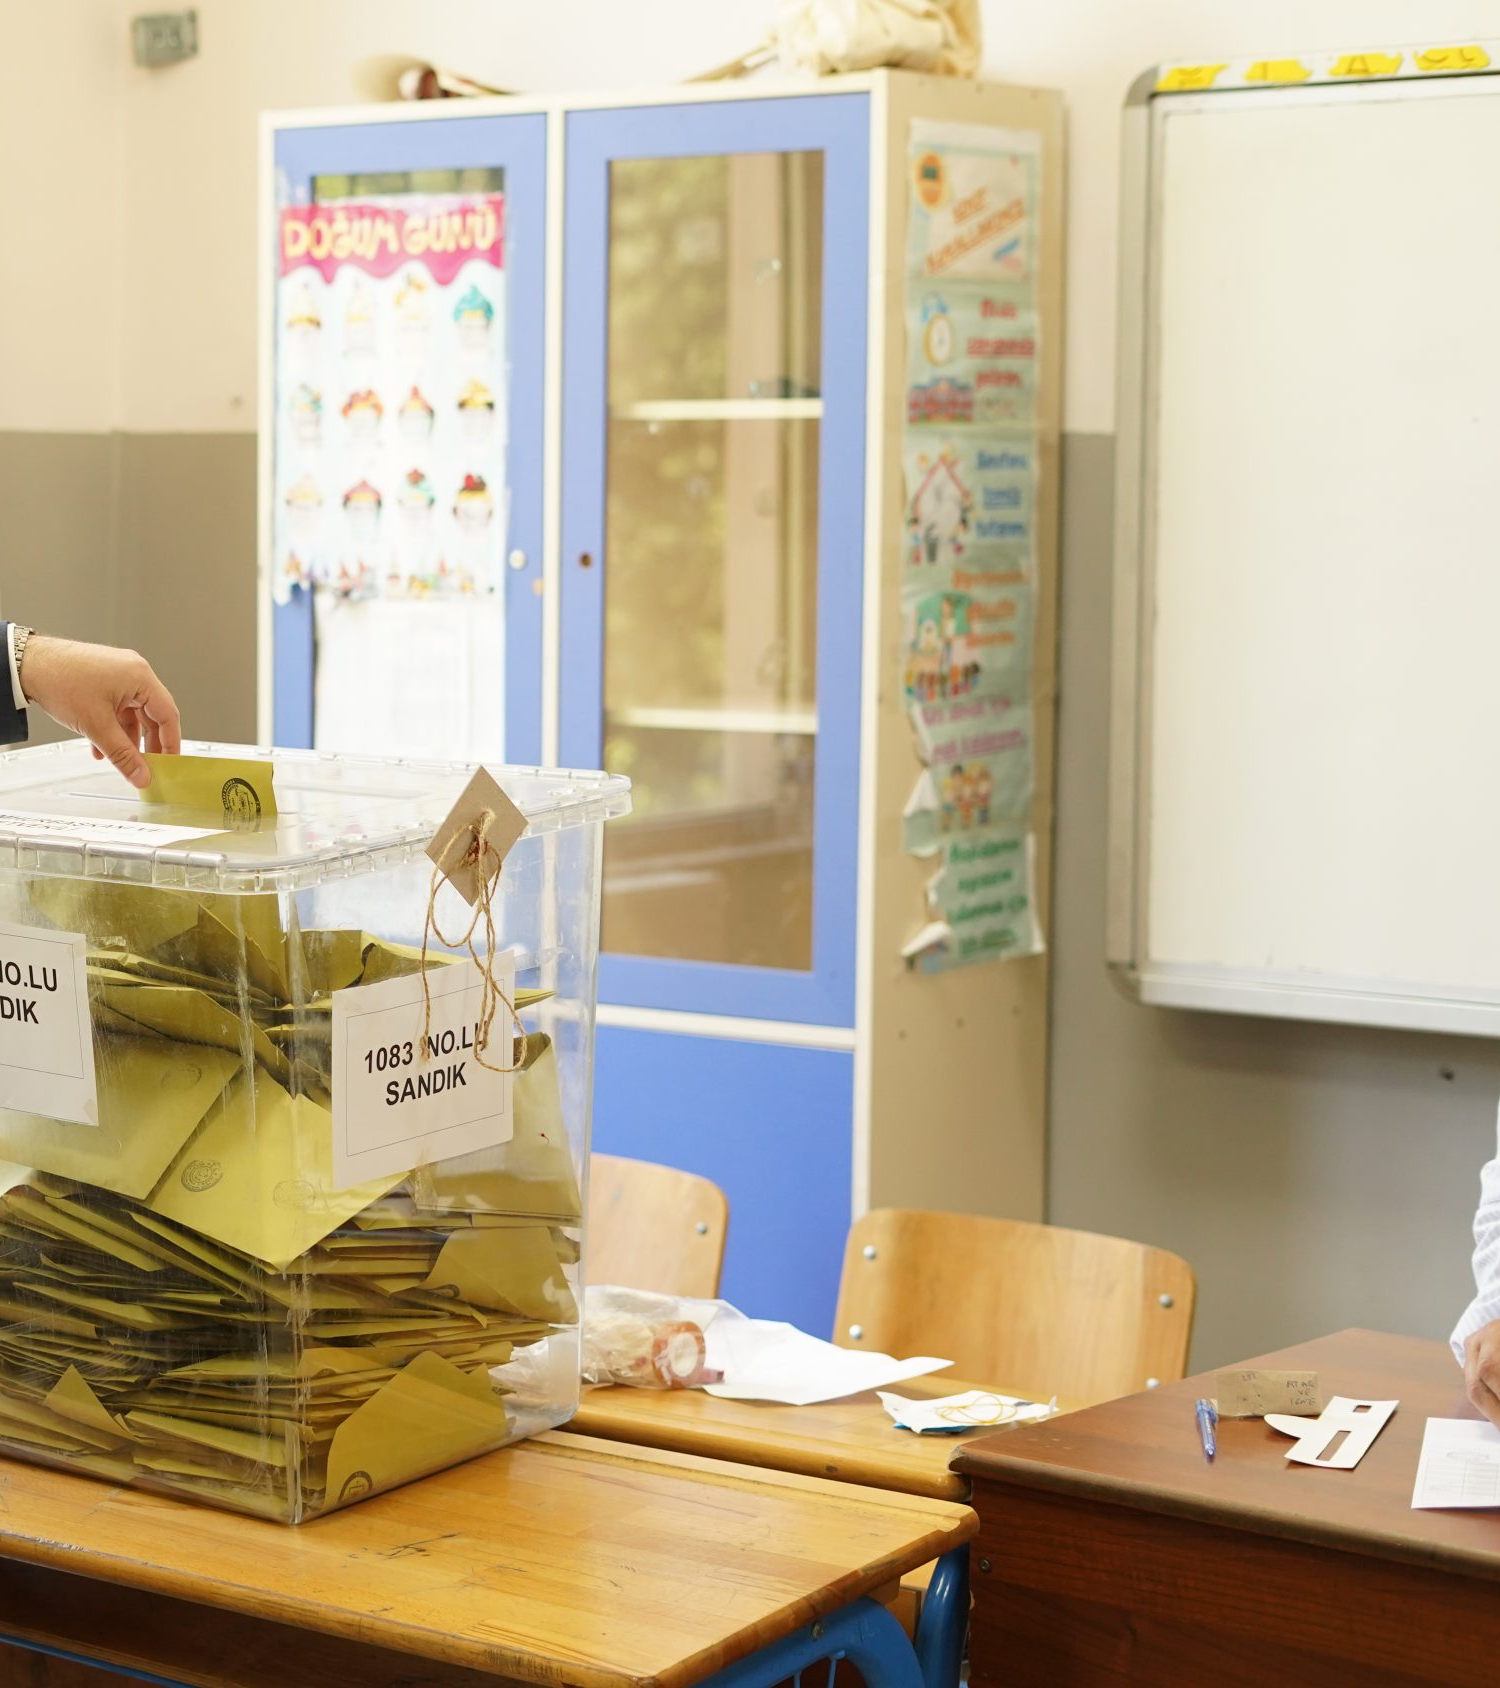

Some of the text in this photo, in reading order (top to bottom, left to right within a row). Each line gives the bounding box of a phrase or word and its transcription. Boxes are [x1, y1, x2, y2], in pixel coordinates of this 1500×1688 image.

[283, 206, 497, 260] DOĞUM GÜNÜ
[364, 1041, 413, 1073] 1083
[386, 1062, 467, 1106] SANDIK
